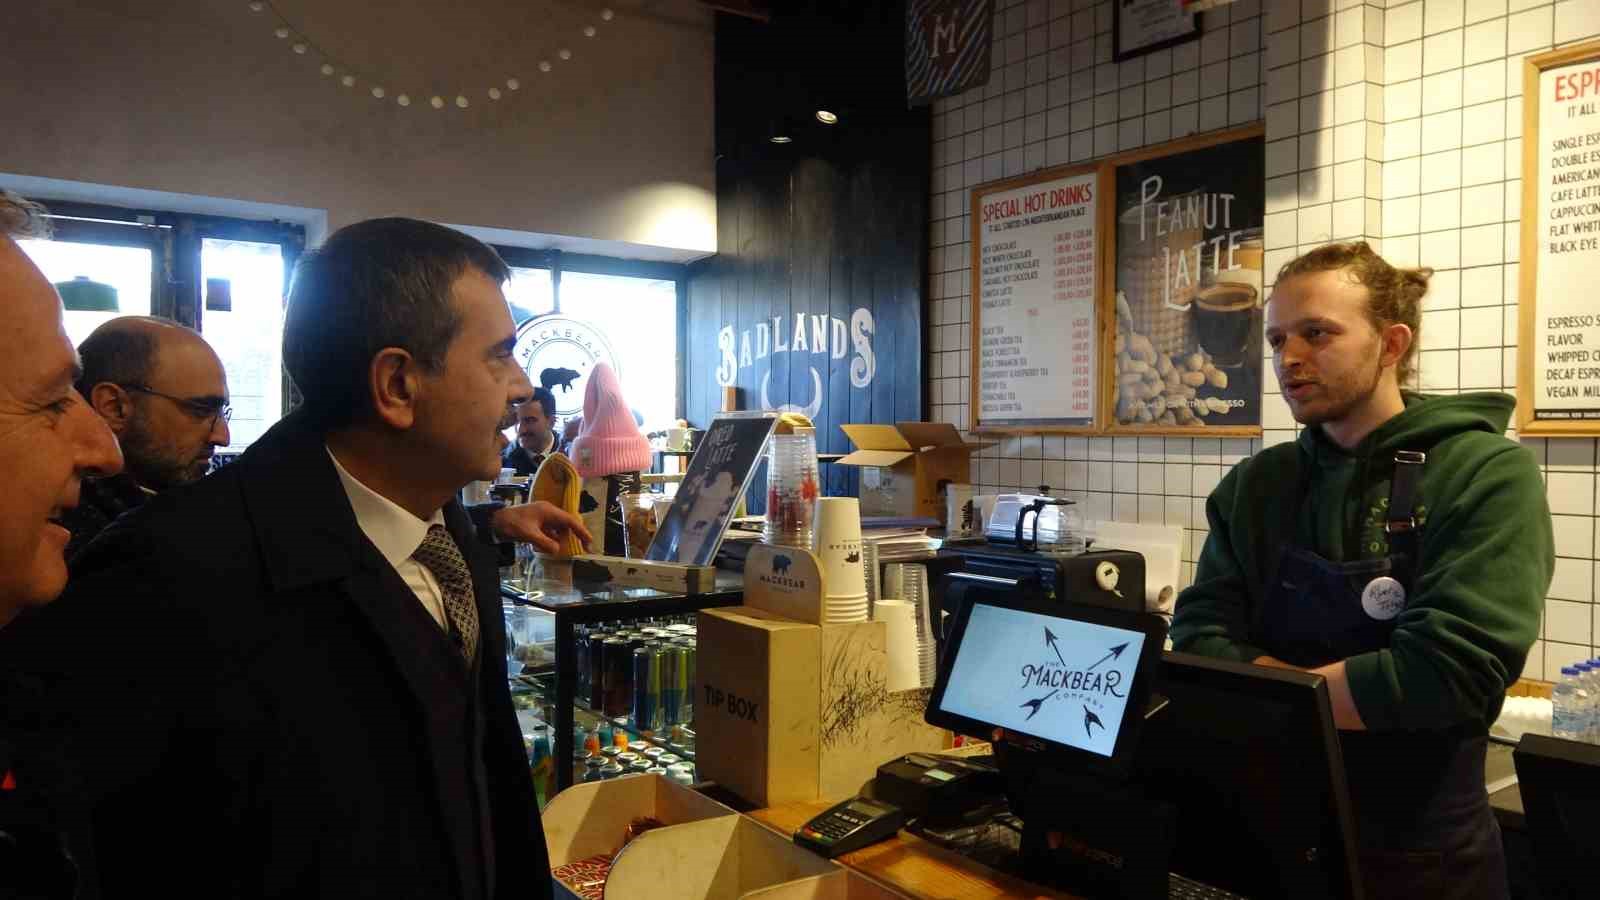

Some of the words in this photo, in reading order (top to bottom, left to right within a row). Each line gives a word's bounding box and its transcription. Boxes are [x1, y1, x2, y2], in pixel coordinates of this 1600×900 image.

[1567, 105, 1576, 118] IT
[1579, 102, 1596, 116] ALL
[1552, 136, 1583, 152] SINGLE
[1551, 153, 1588, 168] DOUBLE
[983, 199, 1022, 223] SPECIAL
[1024, 191, 1046, 213] HOT
[1049, 183, 1093, 208] DRINKS
[1550, 189, 1574, 202] CAFE
[1140, 175, 1236, 241] PEANUT
[1550, 223, 1570, 236] FLAT
[1572, 220, 1600, 234] WHIT
[1550, 240, 1577, 254] BLACK
[1580, 237, 1598, 250] EYE
[1163, 230, 1243, 312] LATTE
[1547, 316, 1594, 329] ESPRESSO
[1547, 333, 1584, 346] FLAVOR
[1547, 350, 1590, 363] WHIPPED
[1592, 350, 1600, 362] C
[1546, 368, 1577, 381] DECAF
[1546, 386, 1579, 398] VEGAN
[1021, 663, 1126, 698] MACKBEAR
[703, 684, 725, 708] TIP
[728, 692, 760, 722] BOX
